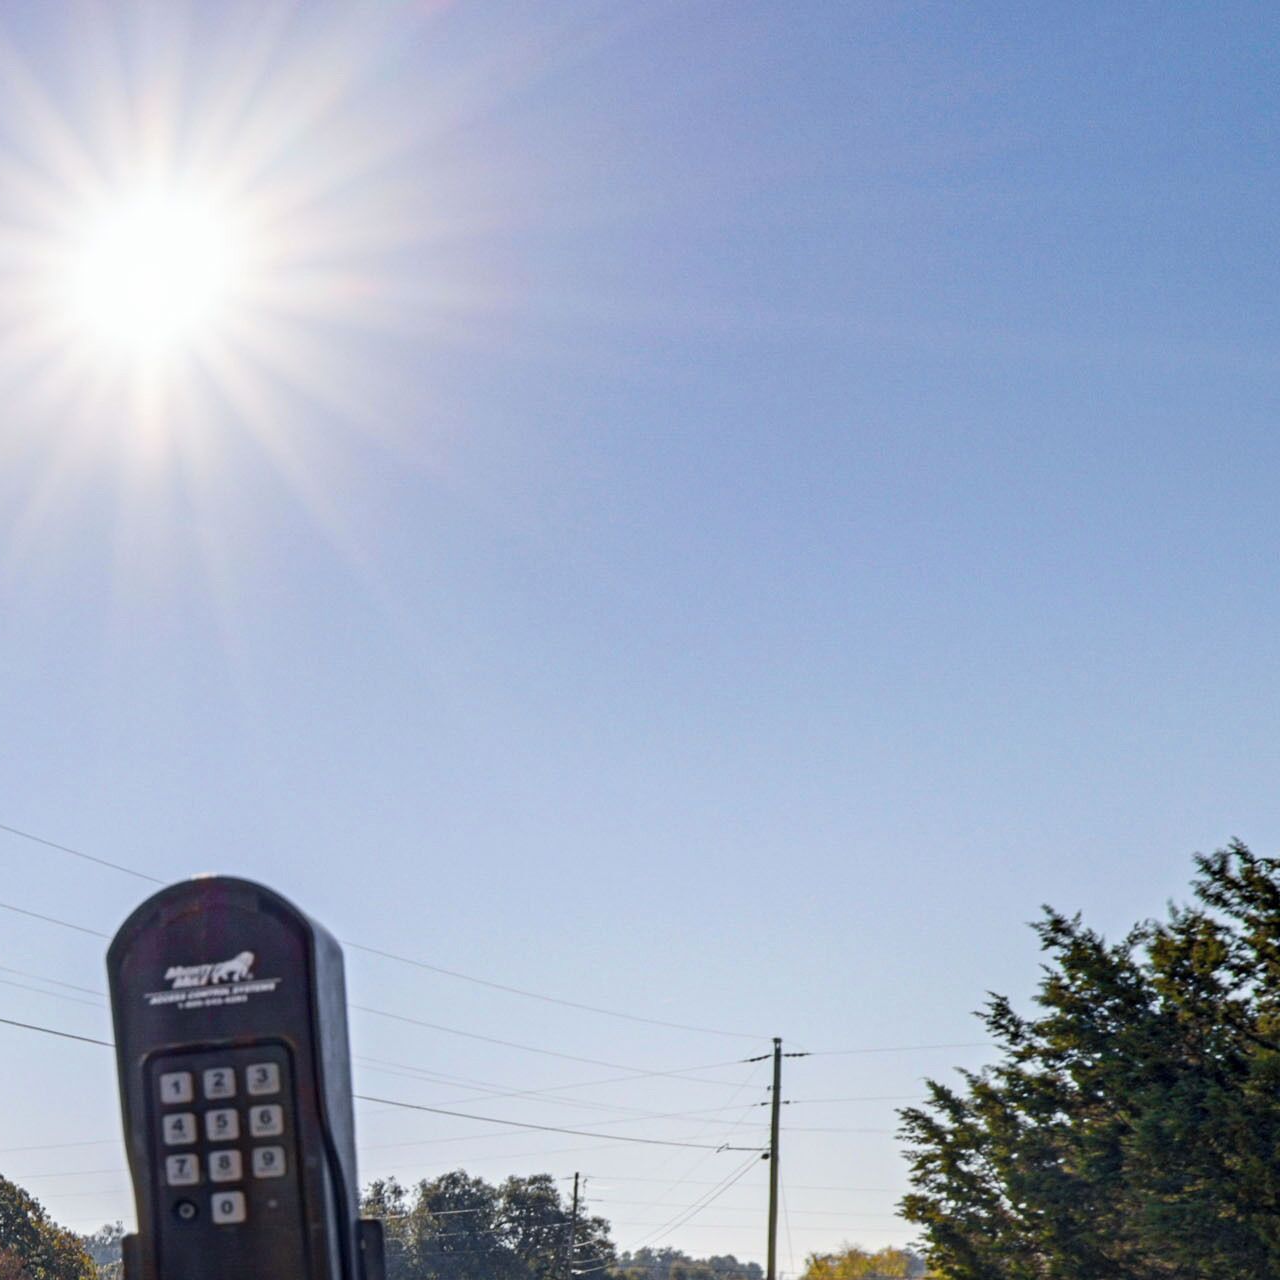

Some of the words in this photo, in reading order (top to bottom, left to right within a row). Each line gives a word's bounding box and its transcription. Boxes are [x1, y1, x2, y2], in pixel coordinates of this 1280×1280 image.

[149, 993, 186, 1005] ACCESS
[187, 988, 230, 999] CONTROL
[232, 982, 276, 994] SYSTEMS
[171, 1080, 181, 1095] 1
[213, 1072, 225, 1087] 2
[255, 1067, 269, 1083] 3
[172, 1118, 184, 1132] 4
[216, 1113, 228, 1128] 5
[259, 1109, 272, 1124] 6
[175, 1158, 187, 1174] 7
[218, 1154, 230, 1170] 8
[262, 1151, 275, 1166] 9
[221, 1200, 234, 1215] 0
